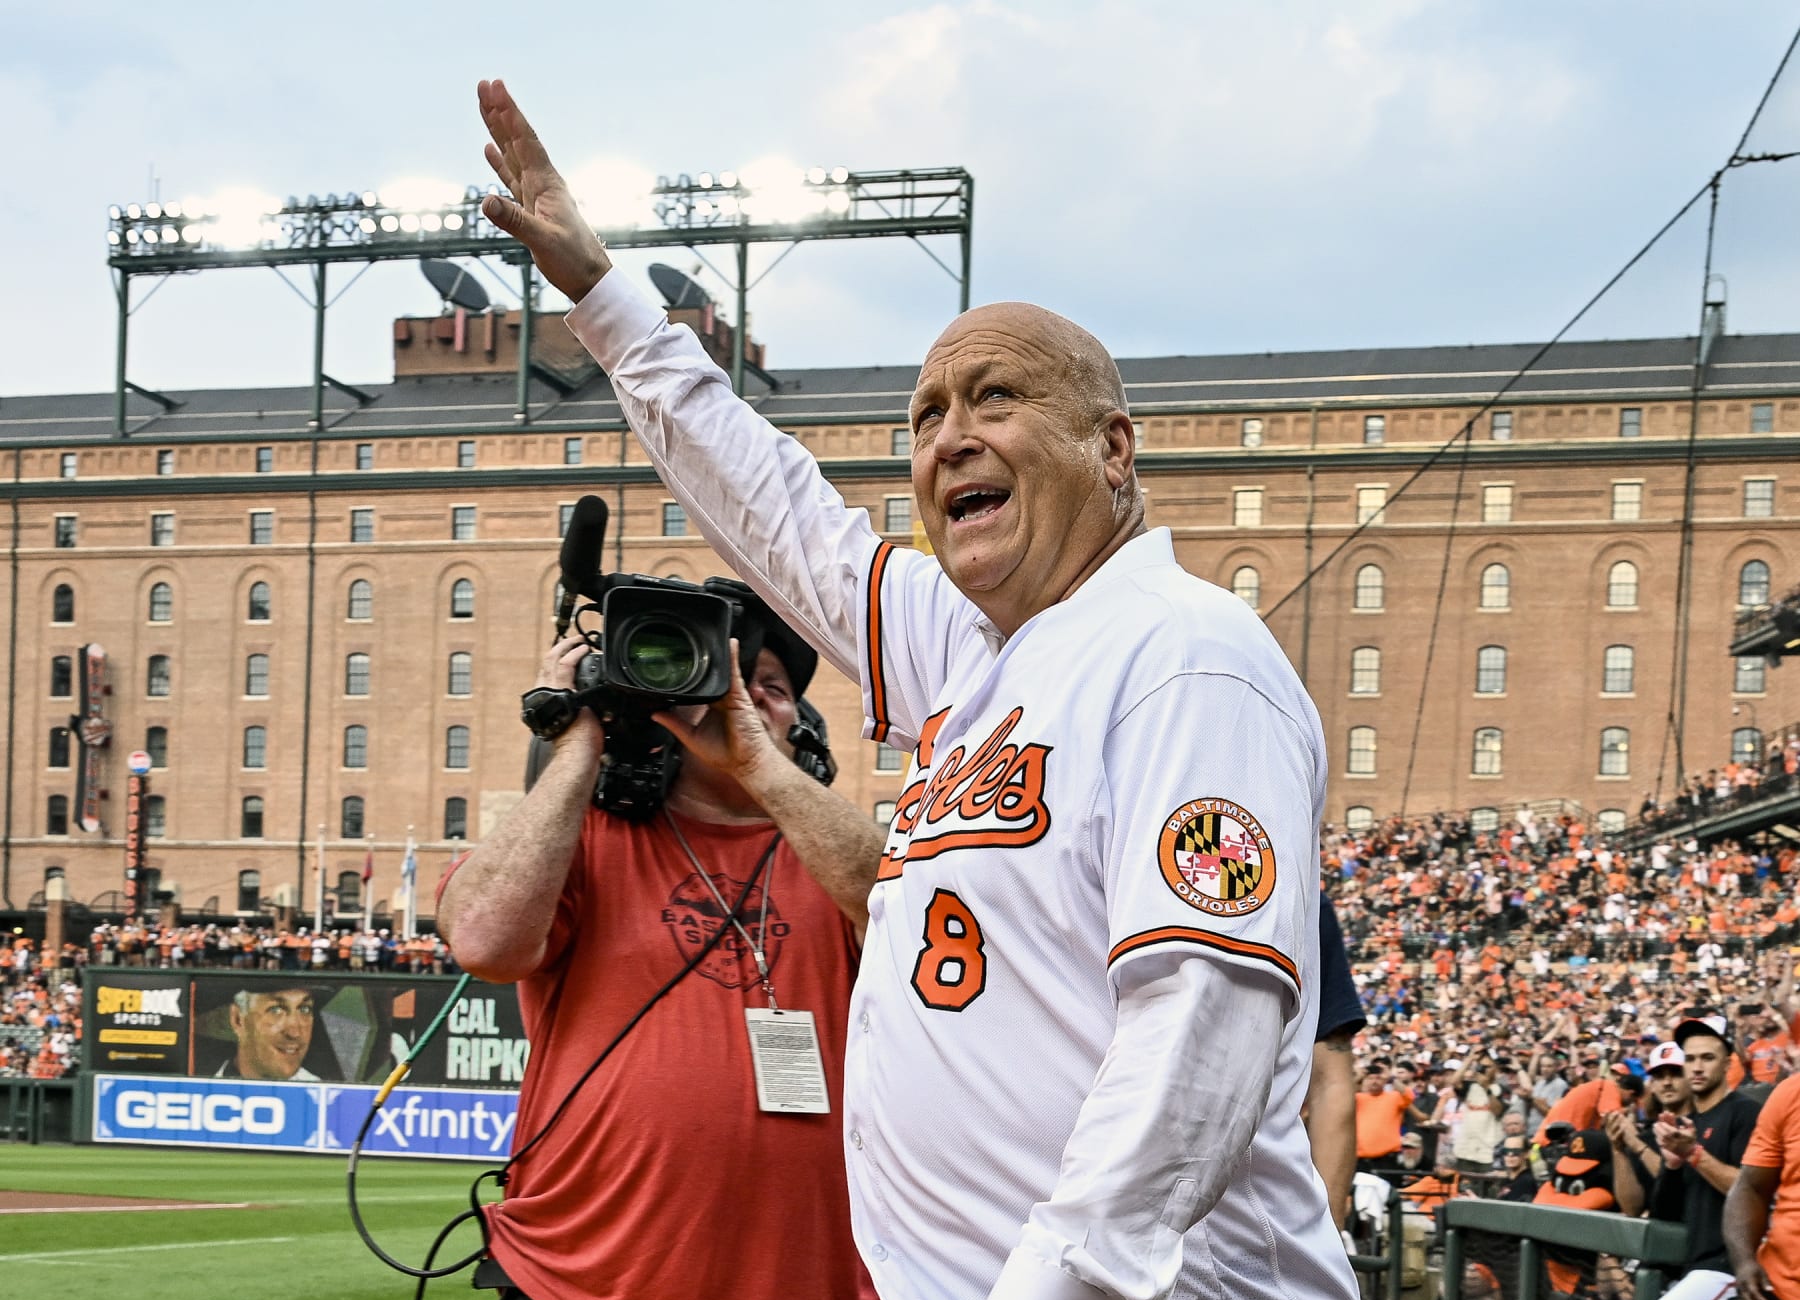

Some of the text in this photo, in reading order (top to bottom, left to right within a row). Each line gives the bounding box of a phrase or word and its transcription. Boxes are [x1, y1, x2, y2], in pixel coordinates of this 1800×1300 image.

[1167, 800, 1271, 852] BALTIMORE
[1175, 881, 1260, 913] ORIOLES
[910, 887, 987, 1012] 8
[114, 1013, 162, 1026] SPORTS
[448, 997, 500, 1035] CAL
[115, 1090, 286, 1135] GEICO
[375, 1095, 518, 1152] xfinity
